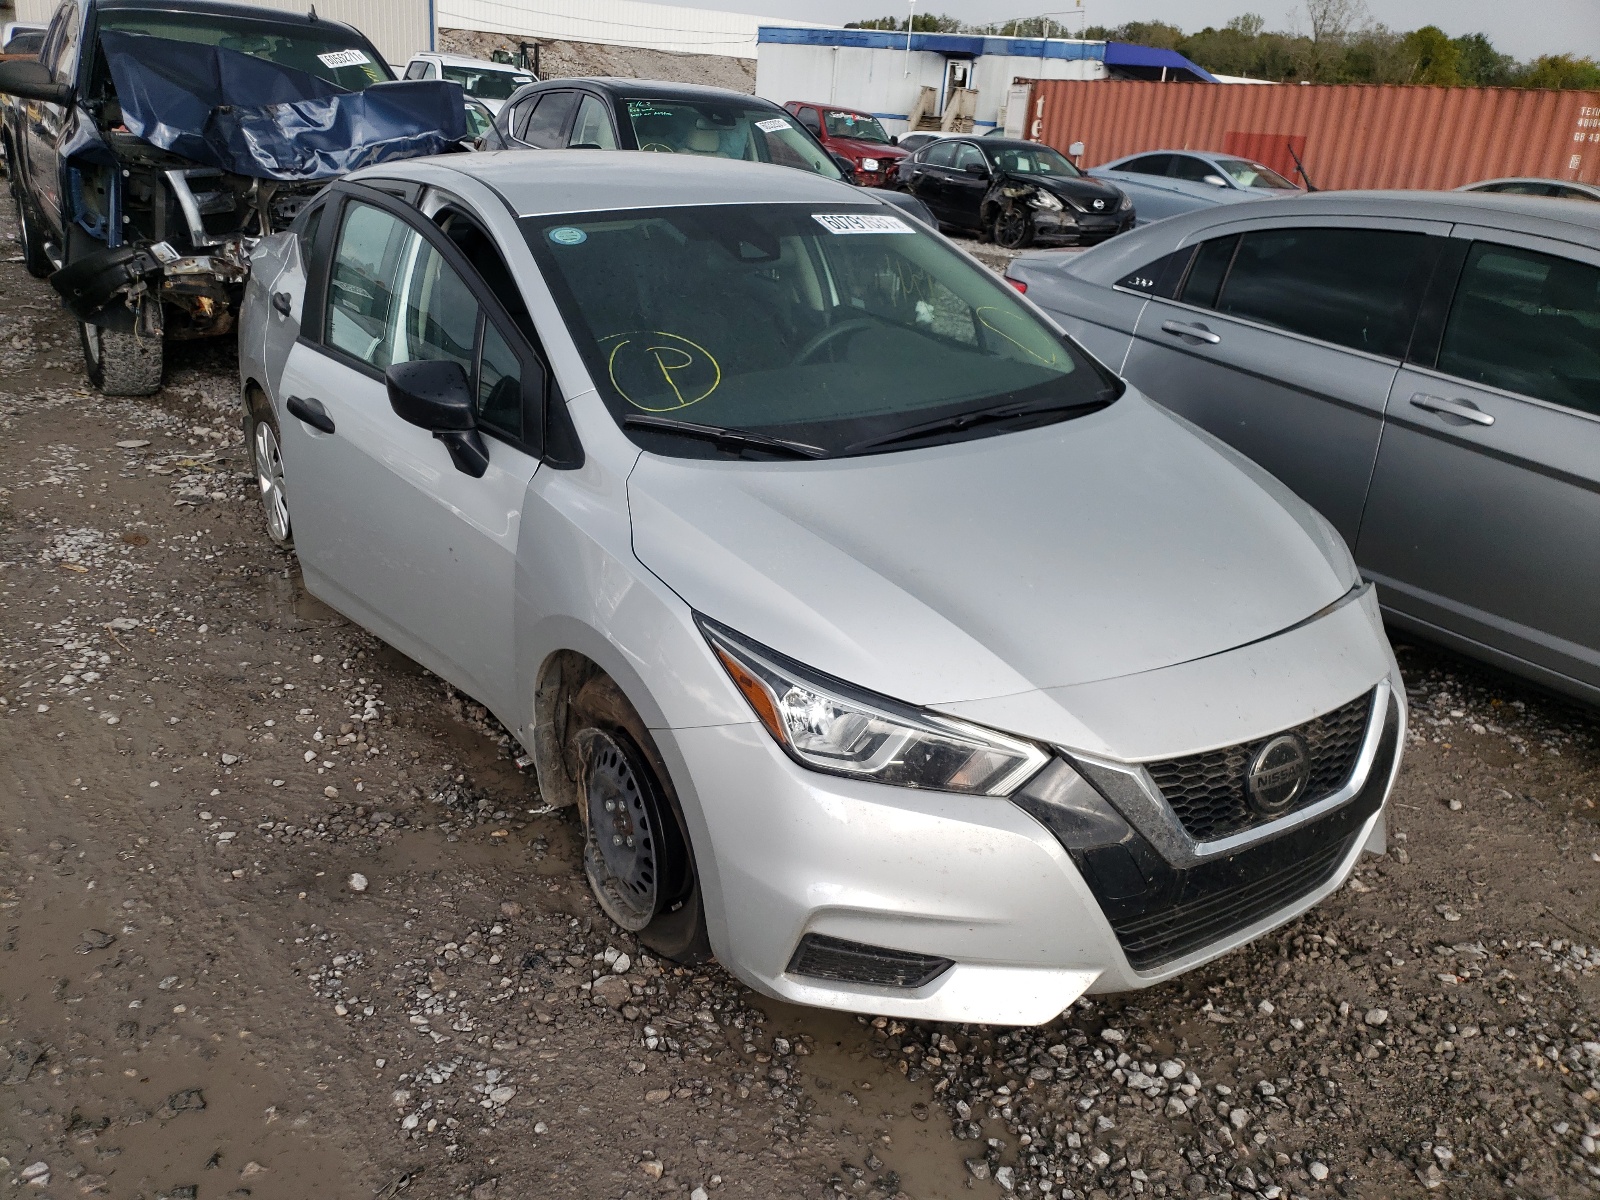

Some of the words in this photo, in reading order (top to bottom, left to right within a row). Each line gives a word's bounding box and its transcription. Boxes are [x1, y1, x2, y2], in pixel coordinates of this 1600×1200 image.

[1029, 94, 1045, 143] te
[644, 346, 692, 404] P
[1257, 762, 1303, 789] NISSAN
